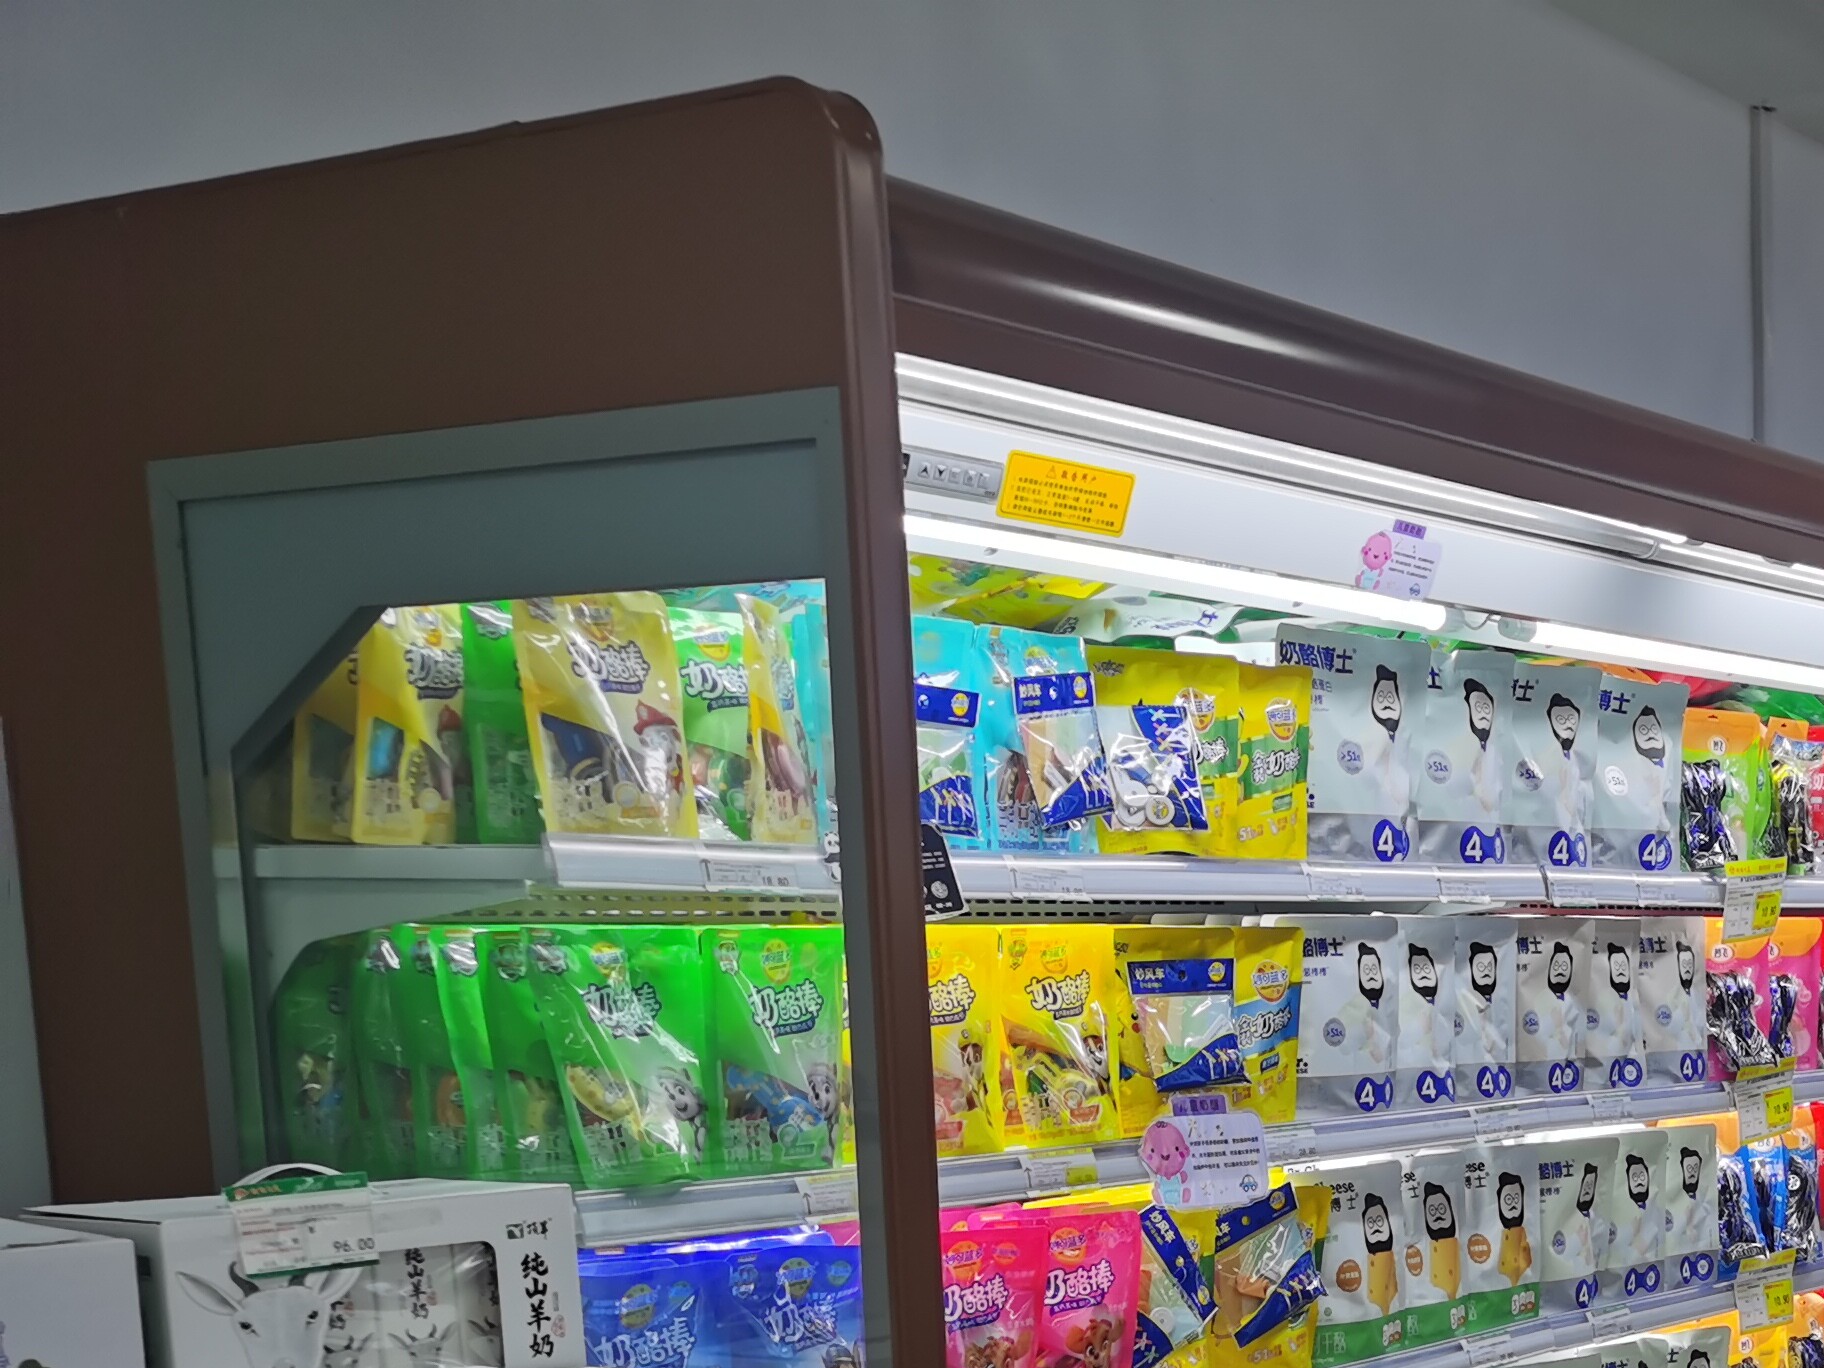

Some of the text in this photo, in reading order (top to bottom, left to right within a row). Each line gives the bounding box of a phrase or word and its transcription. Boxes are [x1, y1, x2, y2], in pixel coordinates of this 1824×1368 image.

[568, 639, 651, 683] 奶酪棒
[1279, 638, 1354, 675] 奶酪博士
[1377, 825, 1395, 857] 4
[1466, 831, 1482, 862] 4
[1552, 836, 1570, 865] 4
[1642, 840, 1657, 866] 4
[1134, 967, 1166, 981] 妙风车
[1024, 968, 1092, 1011] 奶酪棒
[750, 978, 824, 1028] 奶酪棒
[1551, 1069, 1563, 1091] 4
[1611, 1067, 1620, 1083] 4
[1683, 1058, 1694, 1080] 4
[1359, 1082, 1375, 1107] 4
[1421, 1075, 1437, 1099] 4
[1481, 1071, 1494, 1094] 4
[333, 1237, 376, 1253] 96.00
[1627, 1274, 1636, 1291] 4
[1682, 1261, 1691, 1281] 4
[521, 1252, 554, 1359] 纯山羊奶
[1578, 1285, 1589, 1305] 4
[1315, 1331, 1347, 1354] 干酪
